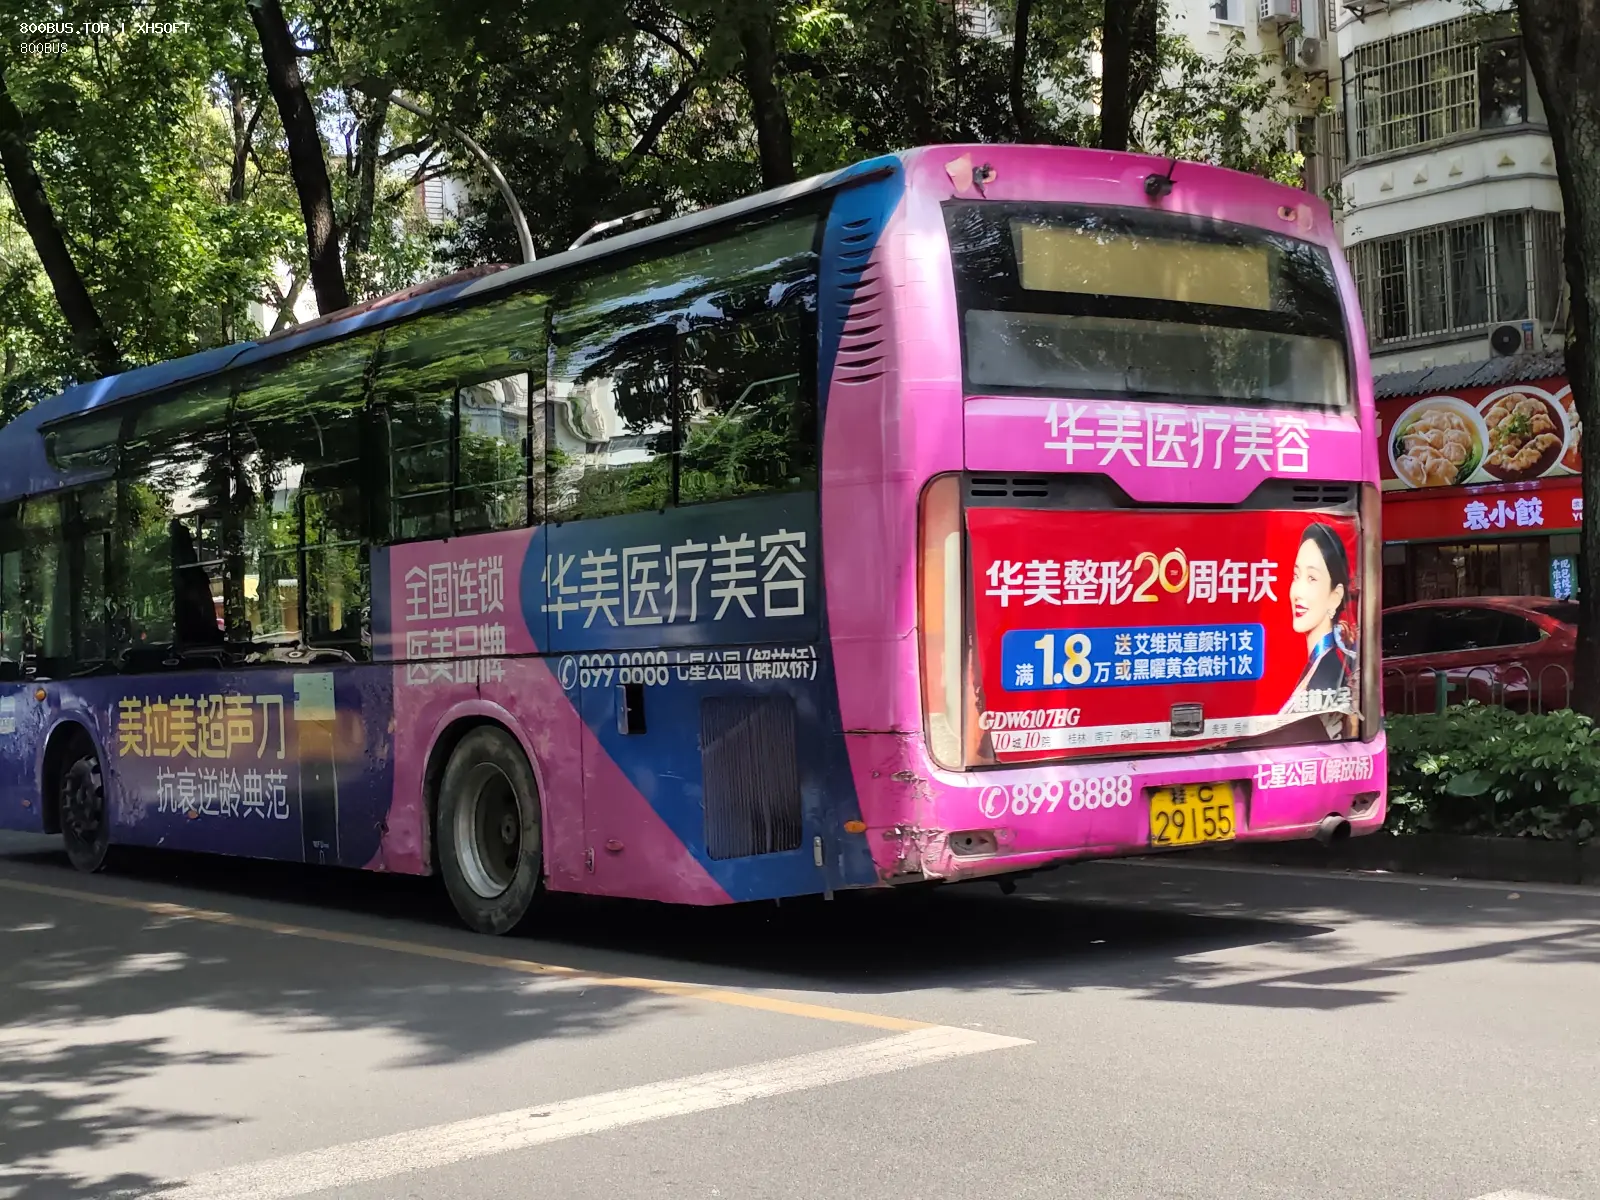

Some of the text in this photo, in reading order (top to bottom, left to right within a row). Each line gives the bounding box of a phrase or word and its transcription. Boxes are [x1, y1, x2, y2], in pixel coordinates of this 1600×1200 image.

[1044, 402, 1310, 473] 华美医疗美容
[404, 555, 504, 621] 全国连锁
[540, 528, 807, 630] 华美医疗美容
[985, 547, 1278, 607] 华美整形20周年庆
[406, 621, 506, 685] 医美品牌
[579, 653, 615, 688] 899
[671, 650, 742, 682] 七星公园
[118, 693, 286, 760] 美拉美超声刀
[979, 708, 1080, 730] GDW6107HG
[156, 766, 289, 820] 抗衰逆龄典范
[1012, 775, 1133, 816] 899 8888
[1253, 755, 1374, 791] 七星公园 (解放桥)
[1156, 805, 1231, 842] 29155
